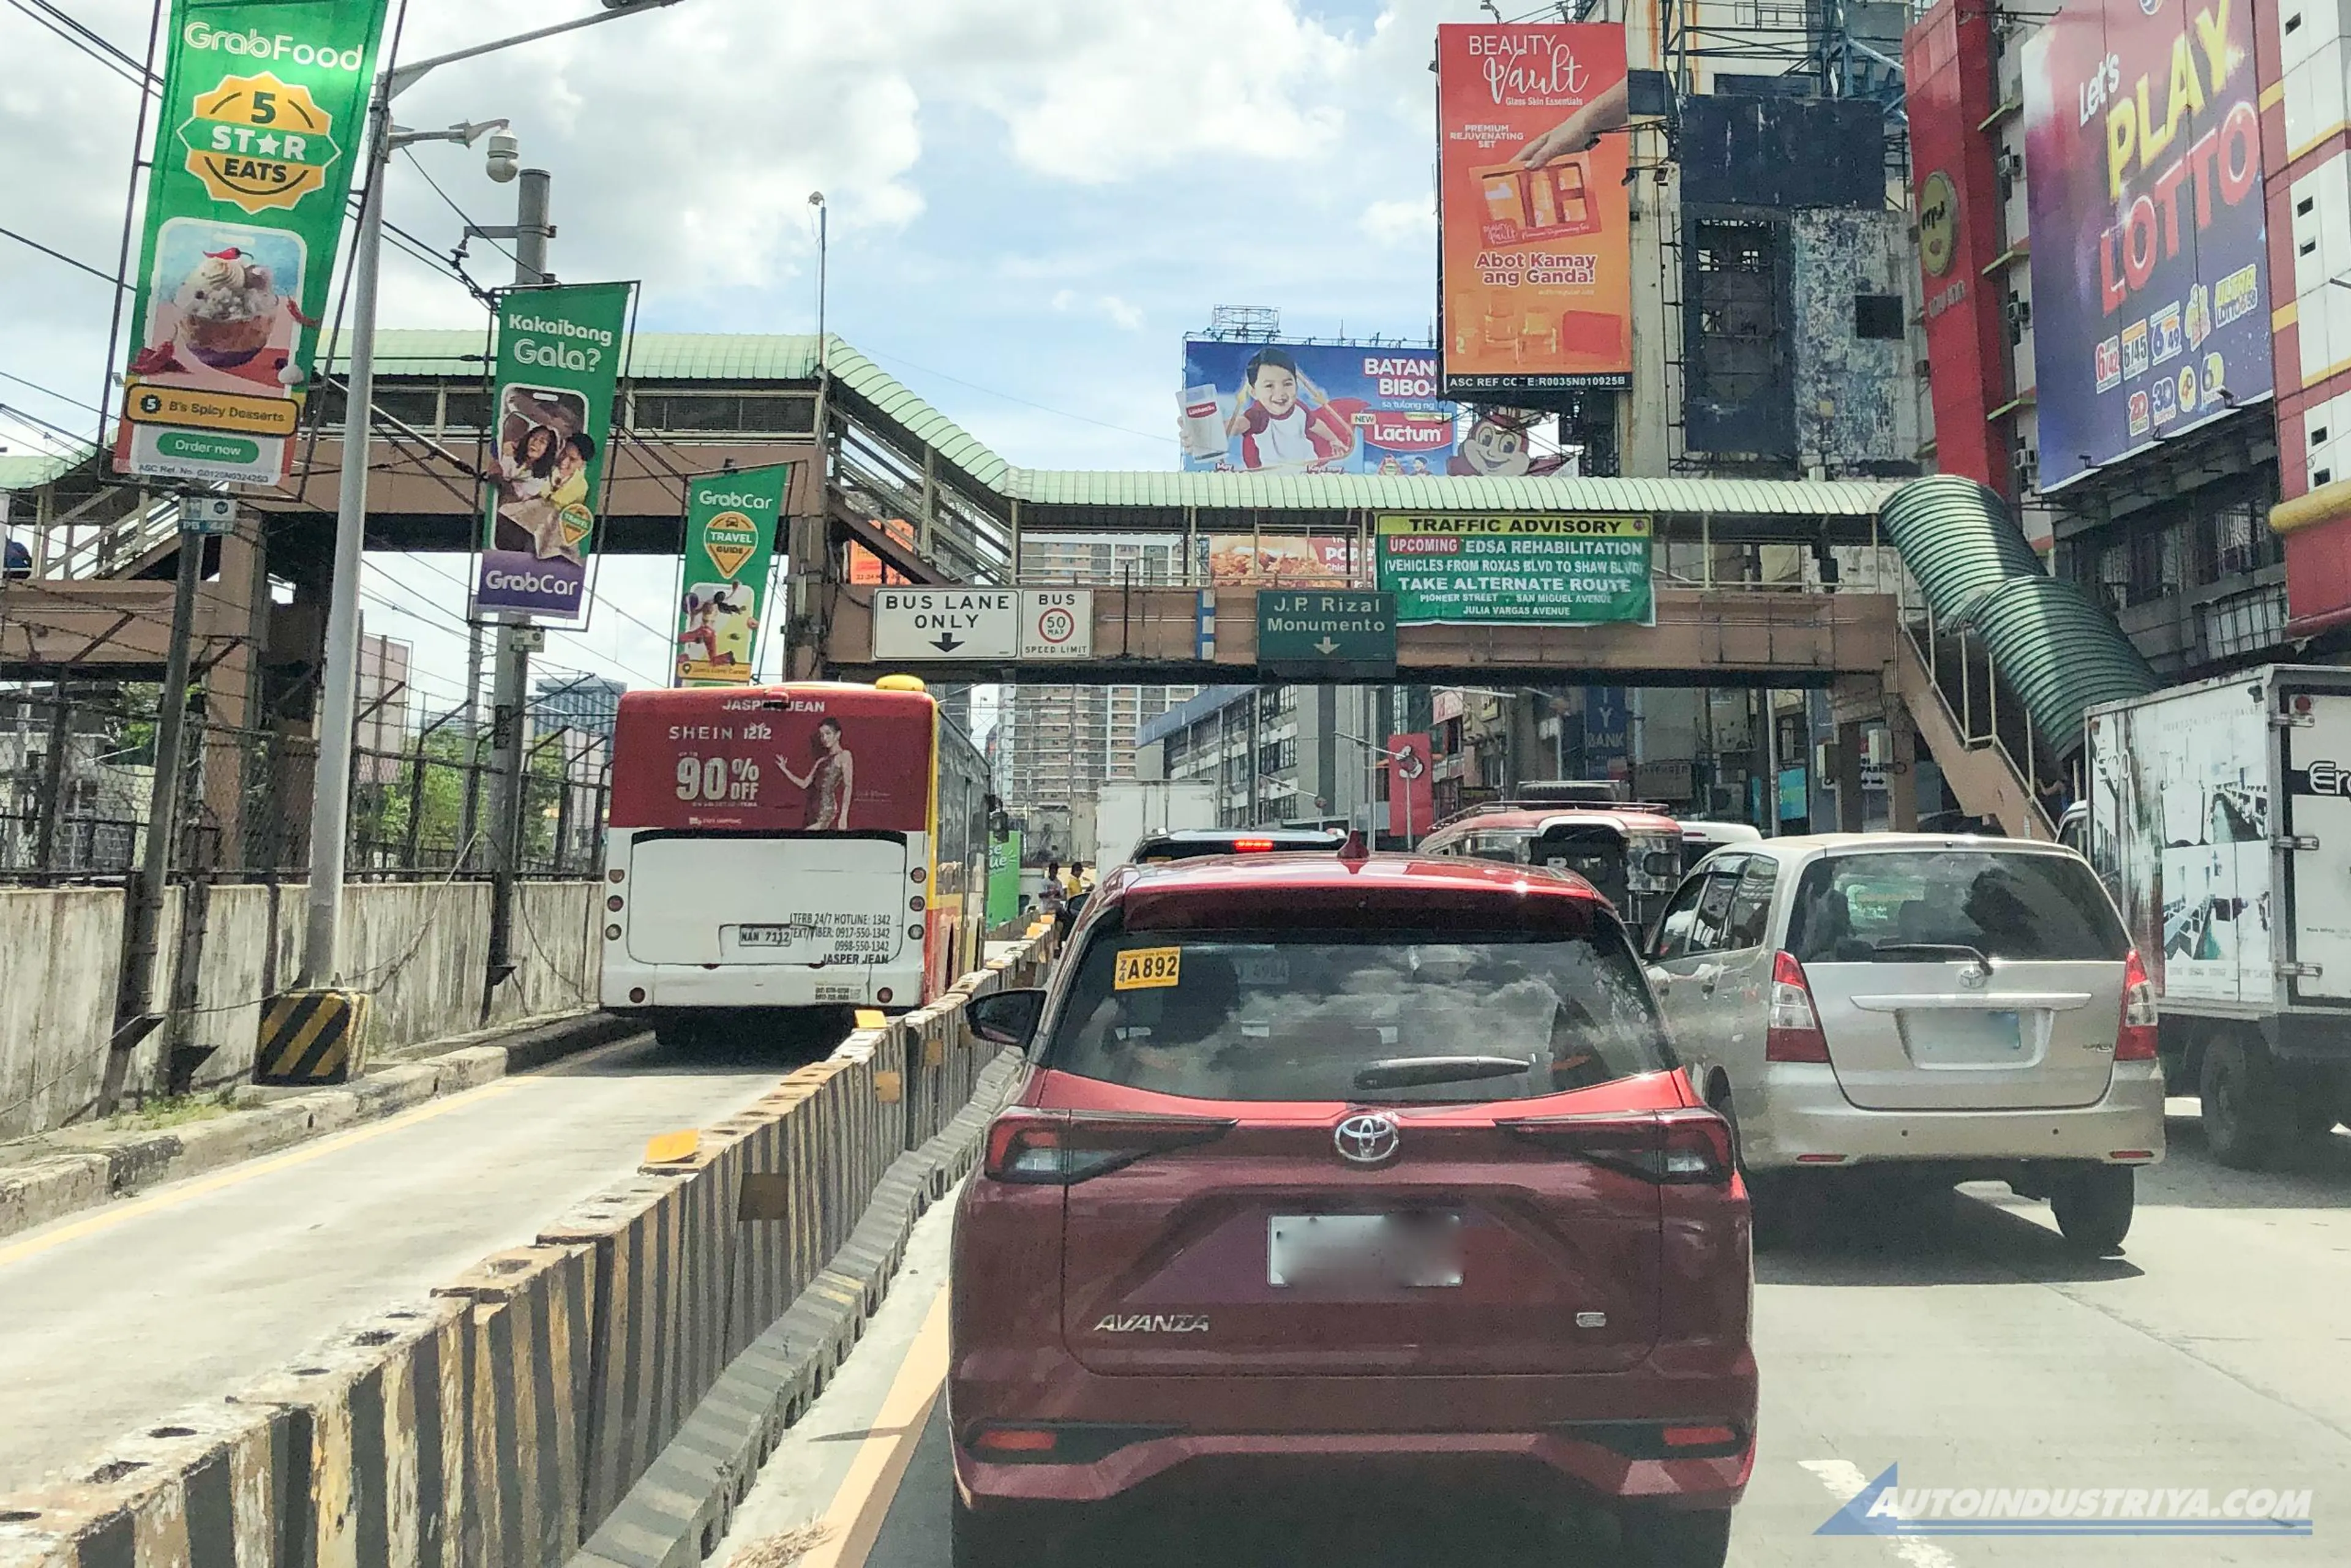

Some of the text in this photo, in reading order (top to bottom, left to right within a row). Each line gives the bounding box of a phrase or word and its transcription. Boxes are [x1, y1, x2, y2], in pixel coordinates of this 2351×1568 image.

[184, 21, 364, 72] GrabFood
[1469, 35, 1556, 55] BEAUTY
[1483, 44, 1589, 104] Vault
[2080, 51, 2120, 127] Let's
[250, 91, 277, 124] 5
[2107, 0, 2236, 206] PLAY
[1449, 132, 1524, 141] REJUVENATING
[1464, 124, 1509, 133] PREMIUM
[1478, 140, 1496, 149] SET
[223, 158, 288, 183] EATS
[2100, 101, 2259, 317] LOTTO
[1475, 252, 1597, 269] Abot Kamay
[1483, 269, 1595, 287] ang Ganda!
[509, 313, 612, 347] Kakaibang
[513, 339, 602, 372] Gala?
[2124, 335, 2147, 368] 6/45
[1365, 358, 1436, 377] BATAN
[1477, 378, 1499, 386] REF
[146, 399, 285, 422] 5 B's Spicy Desserts
[175, 439, 242, 456] Order now
[699, 490, 773, 511] GrabCar
[1409, 519, 1622, 533] TRAFFIC ADVISORY
[710, 531, 752, 543] TRAVEL
[1390, 538, 1458, 552] UPCOMING
[1466, 540, 1507, 553] EDSA
[1511, 541, 1643, 555] REHABILITATION
[1385, 558, 1444, 574] (VEHICLES
[1447, 559, 1479, 572] FROM
[1482, 560, 1520, 572] ROXAS
[1523, 560, 1553, 573] BLVD
[1556, 560, 1572, 573] TO
[1575, 560, 1607, 574] SHAW
[486, 570, 579, 597] GrabCar
[1398, 577, 1632, 592] TAKE ALTERNATE ROUTE
[886, 595, 1010, 609] BUS LANE
[1039, 594, 1075, 605] BUS
[1274, 596, 1380, 612] J.P. Rizal
[1420, 593, 1460, 602] PIONEER
[1463, 593, 1498, 602] STREET
[1516, 594, 1535, 602] SAN
[1537, 594, 1573, 603] MIGUEL
[1463, 606, 1571, 615] JULIA VARGAS AVENUE
[914, 614, 980, 628] ONLY
[1047, 616, 1066, 628] 50
[1267, 617, 1385, 631] Monumento
[786, 700, 825, 712] JEAN
[669, 726, 733, 740] SHEIN
[1588, 732, 1624, 748] BANK
[730, 782, 759, 800] OFF
[815, 912, 832, 925] 24/7
[873, 914, 890, 925] 1342
[836, 927, 890, 939] 0917-550-1342
[835, 940, 889, 951] 0998-550-1342
[822, 953, 889, 965] JASPER JEAN
[1127, 956, 1177, 980] A892
[1093, 1315, 1210, 1332] AVANZA
